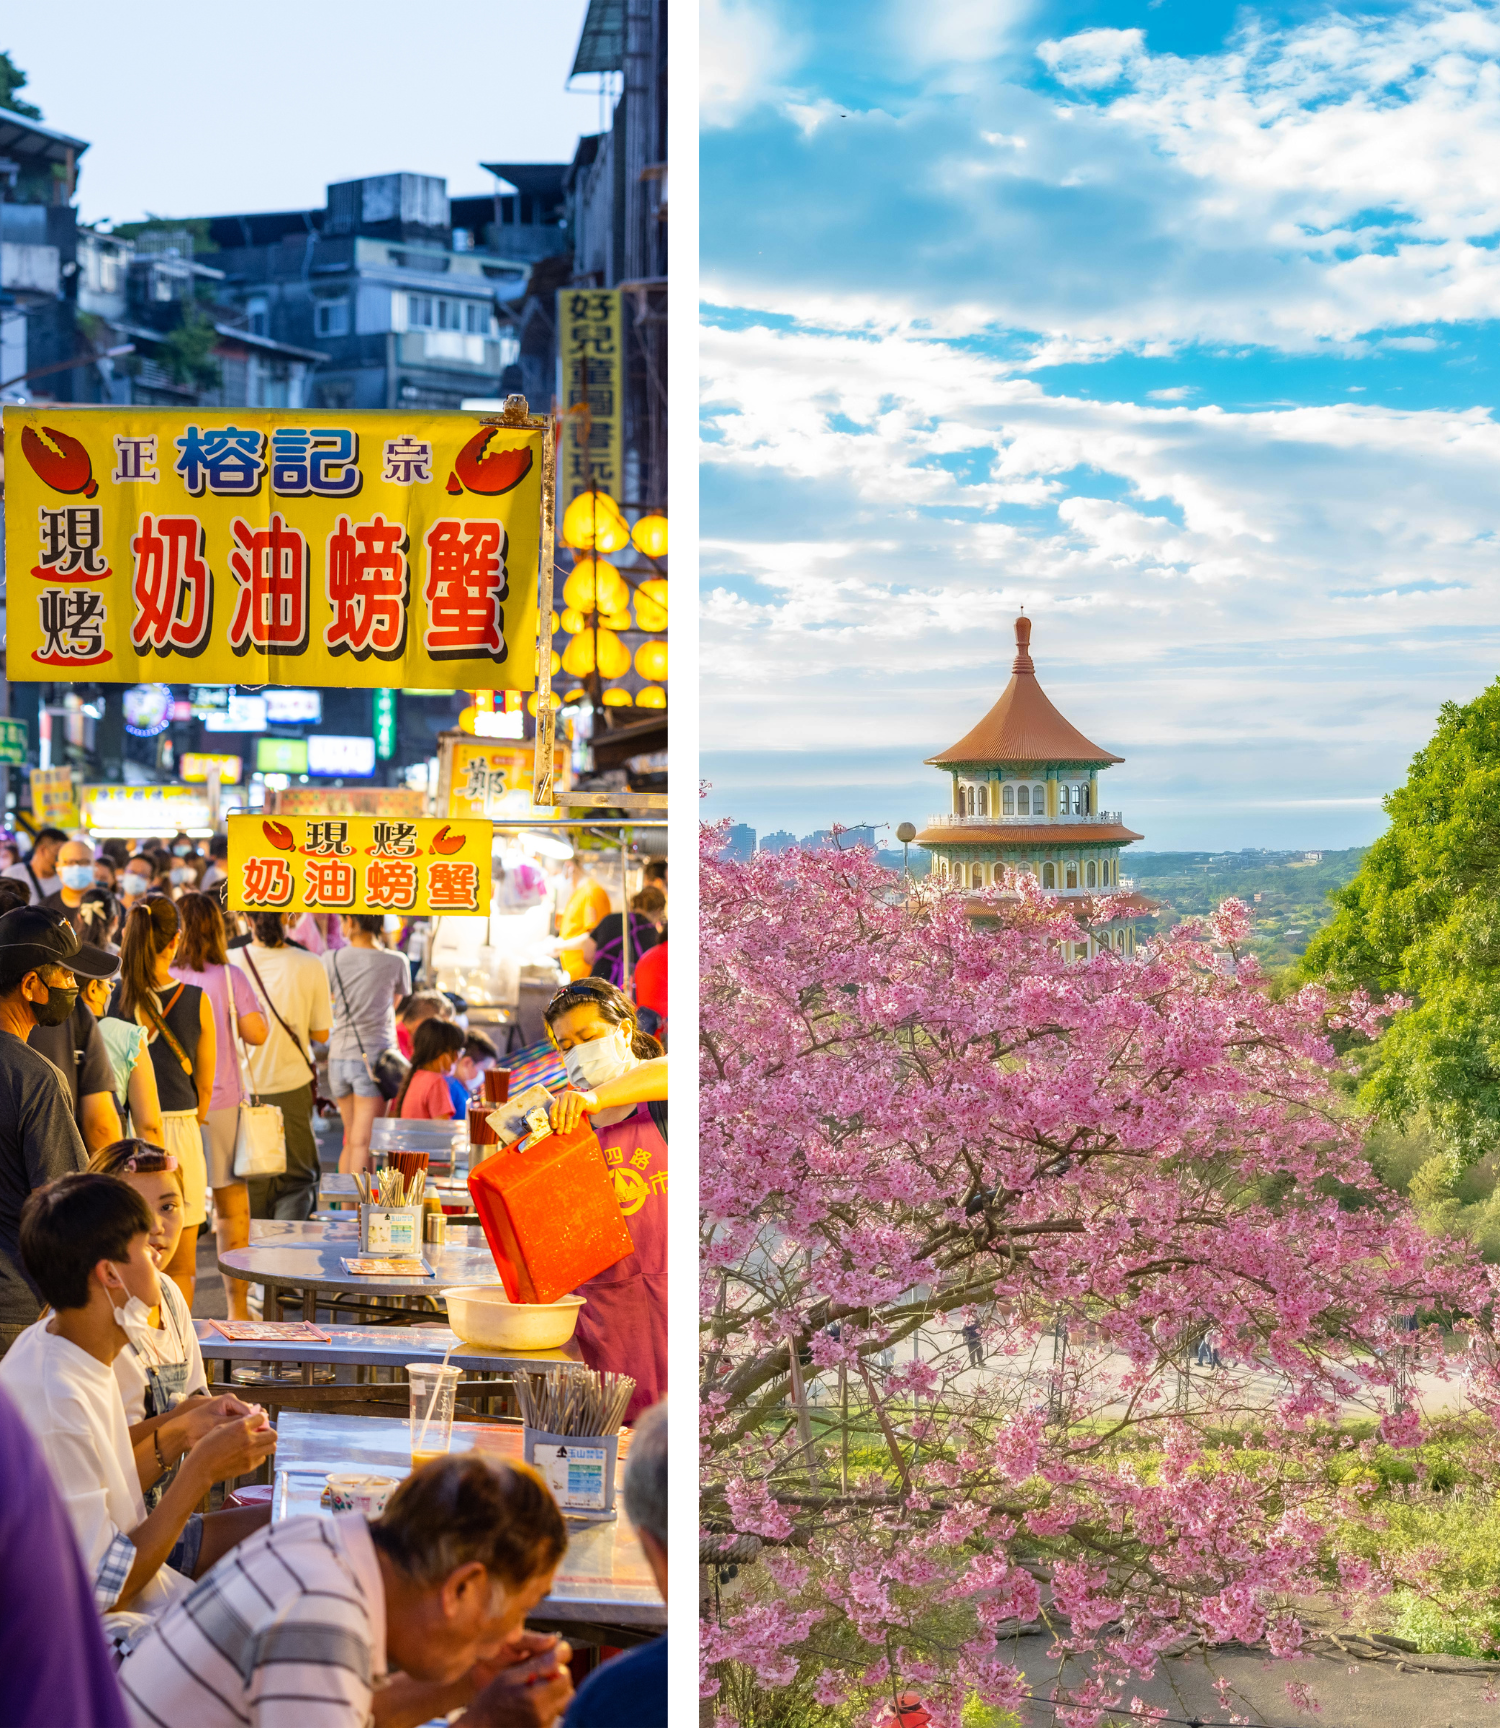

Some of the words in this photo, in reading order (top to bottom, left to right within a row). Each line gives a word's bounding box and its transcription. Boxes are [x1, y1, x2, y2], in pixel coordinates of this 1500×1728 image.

[569, 293, 615, 502] 好兒童圖書玩
[116, 441, 156, 480] 正
[176, 427, 357, 494] 榕記
[387, 440, 429, 480] 宗
[40, 508, 105, 659] 現烤
[131, 513, 503, 654] 奶油螃蟹
[306, 821, 418, 856] 現烤
[242, 858, 477, 907] 奶油螃蟹
[604, 1146, 652, 1171] 四路
